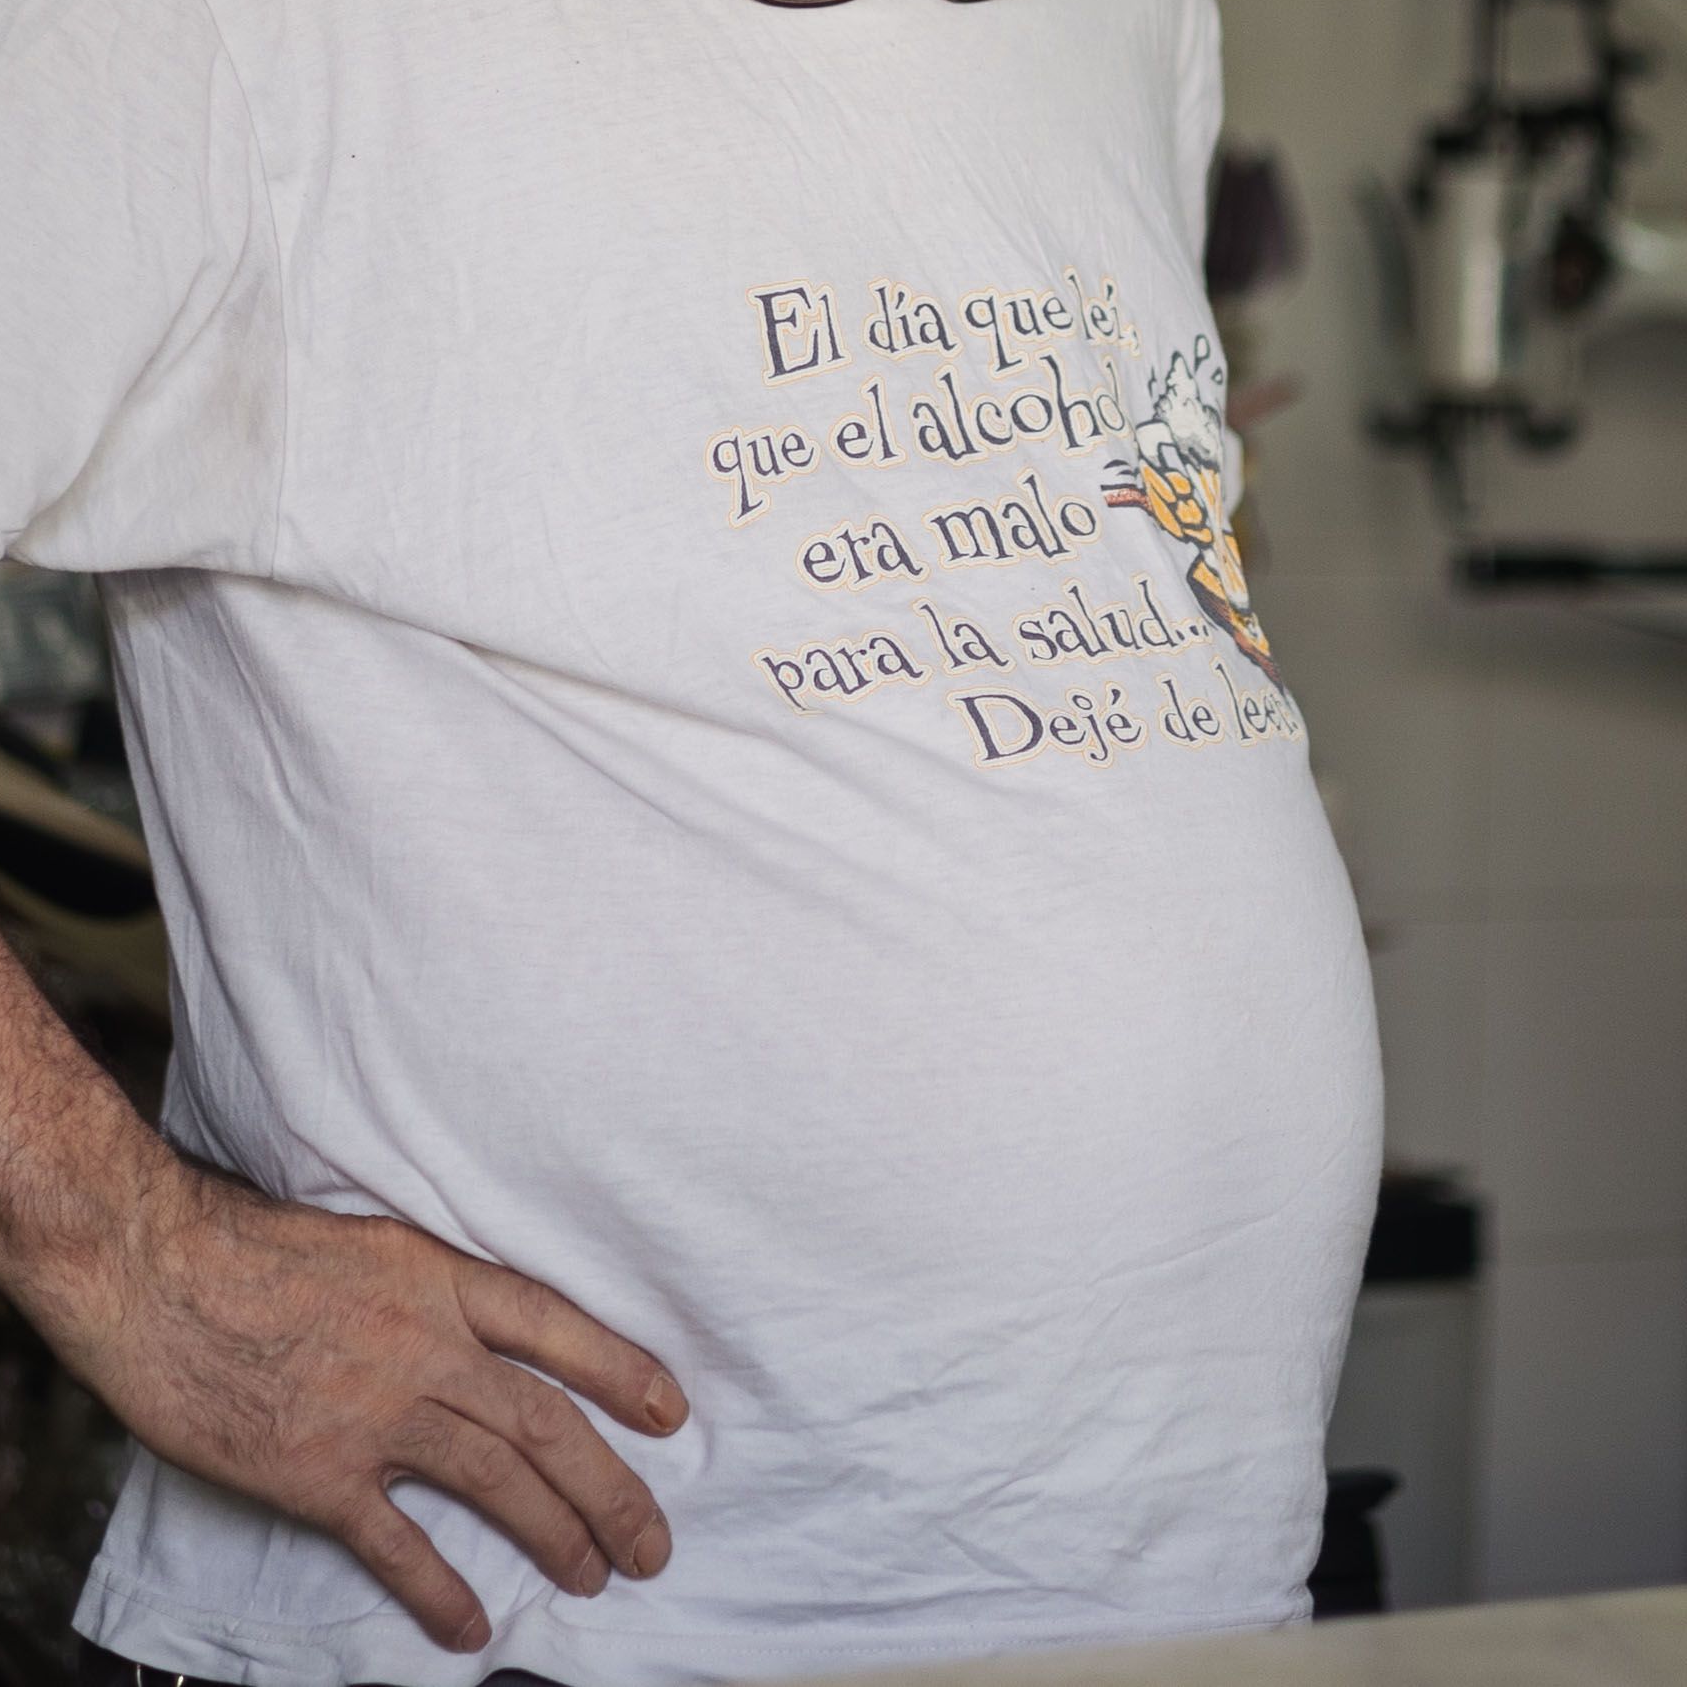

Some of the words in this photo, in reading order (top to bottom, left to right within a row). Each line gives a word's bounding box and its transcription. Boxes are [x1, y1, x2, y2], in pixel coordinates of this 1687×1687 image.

[755, 287, 844, 378] El
[870, 279, 957, 356] día
[965, 288, 1074, 369] que
[712, 425, 813, 520] que
[837, 384, 899, 462] el
[911, 356, 1127, 459] alcohol
[803, 520, 923, 584] era
[933, 475, 1098, 563] malo
[760, 631, 925, 708] para
[921, 602, 1008, 670] la
[1014, 580, 1210, 661] salud...
[956, 688, 1140, 763] Dejé
[1165, 680, 1220, 745] de
